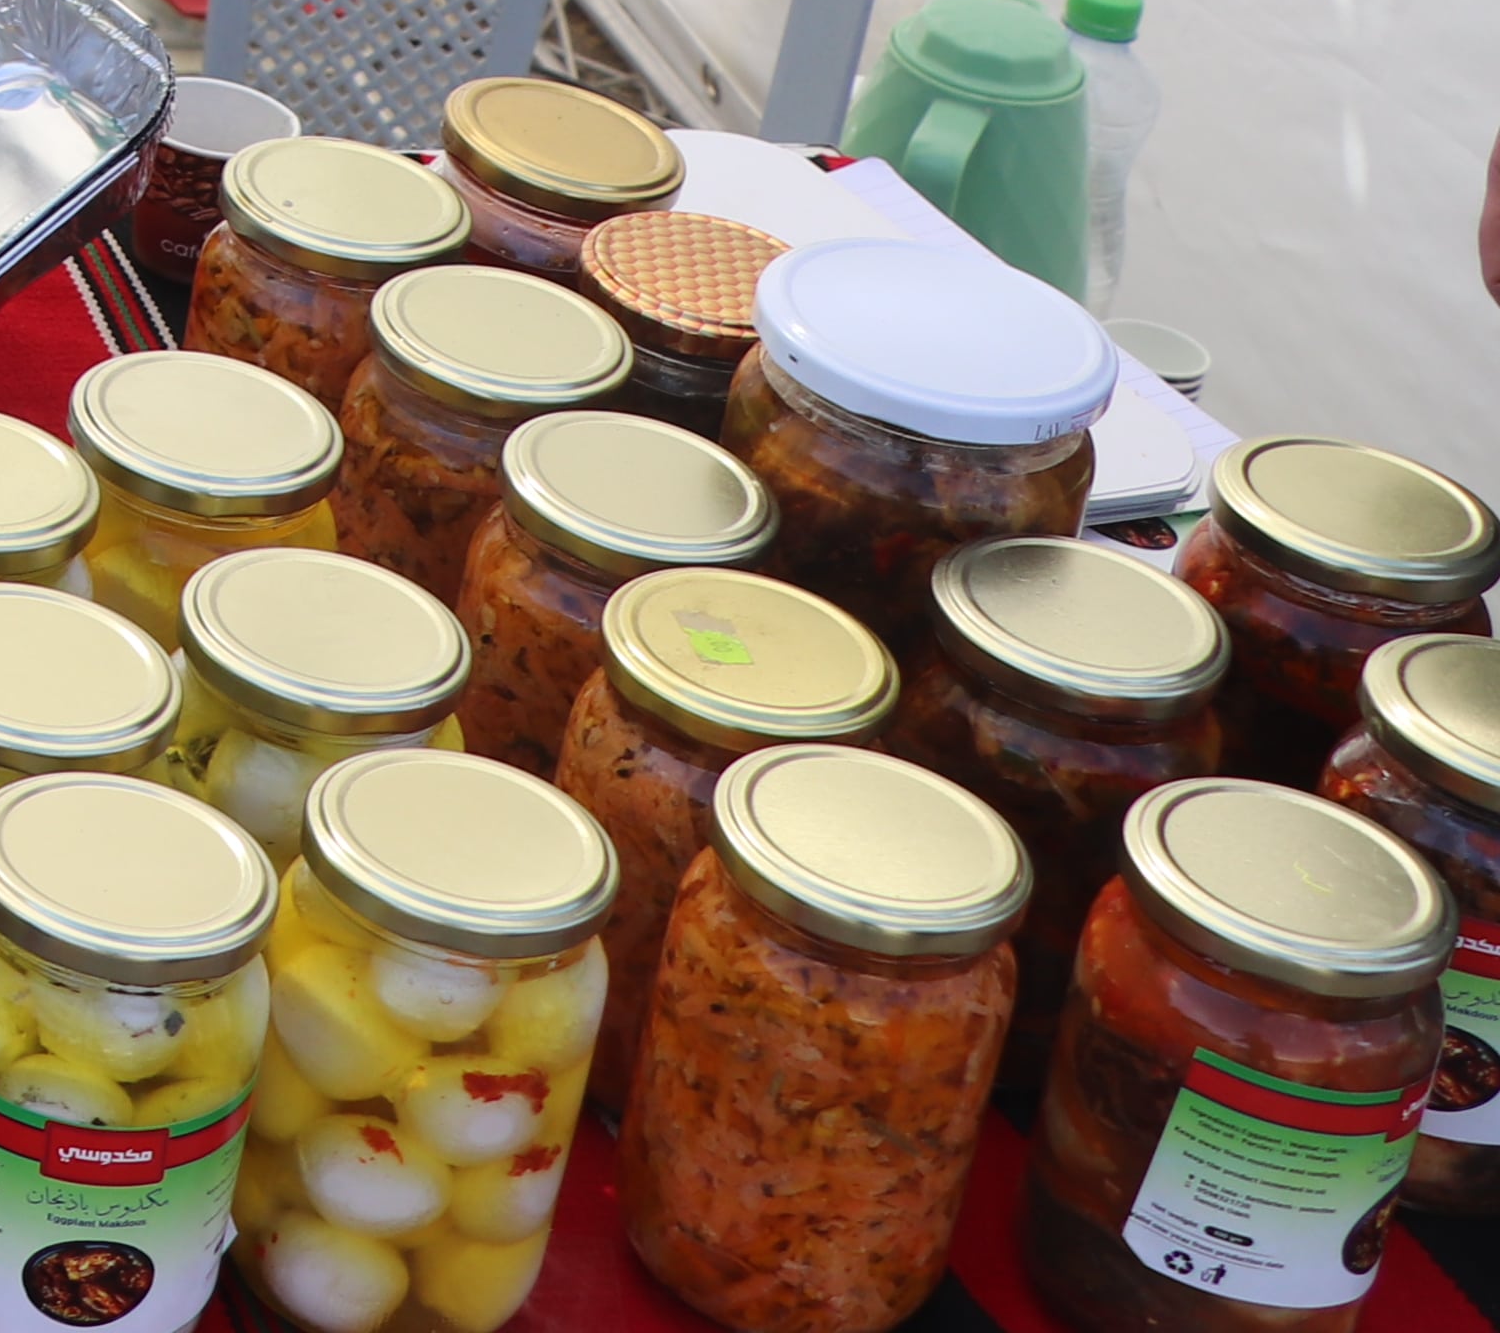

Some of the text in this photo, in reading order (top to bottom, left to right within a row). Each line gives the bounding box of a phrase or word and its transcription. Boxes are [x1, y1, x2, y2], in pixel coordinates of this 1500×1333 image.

[57, 1146, 154, 1167] مكدوسي
[46, 1211, 148, 1230] Eggplant Makdous
